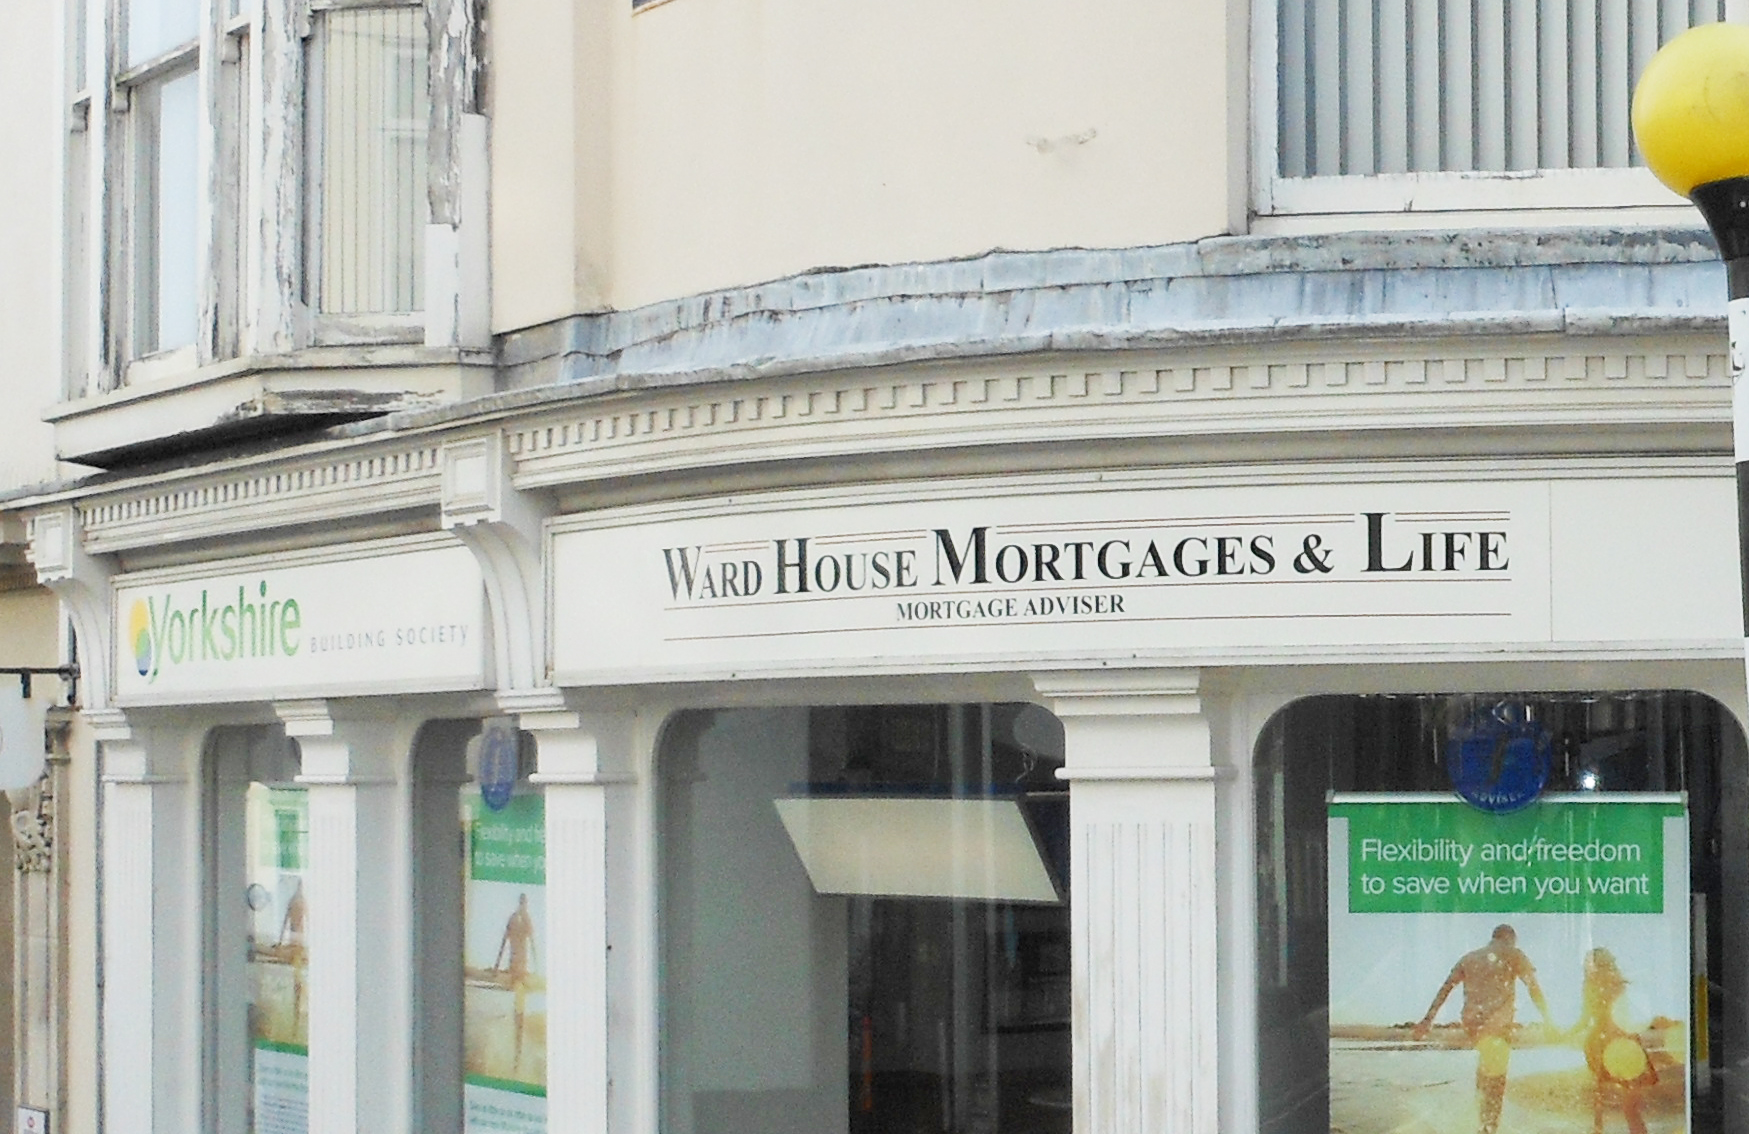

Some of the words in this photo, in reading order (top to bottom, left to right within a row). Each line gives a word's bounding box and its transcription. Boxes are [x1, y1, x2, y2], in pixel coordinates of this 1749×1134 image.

[662, 544, 763, 601] WARD
[773, 536, 919, 595] HOUSE
[931, 526, 1277, 587] MORTGAGES
[1292, 532, 1335, 574] &
[1360, 511, 1511, 573] LIFE
[896, 596, 1018, 622] MORTGAGE
[1023, 593, 1126, 617] ADVISER
[310, 629, 386, 653] BUILDING
[395, 624, 469, 648] SOCIETY
[1361, 838, 1474, 868] Flexibility
[1480, 838, 1528, 862] and
[1534, 837, 1641, 862] freedom
[1361, 873, 1386, 895] to
[1392, 875, 1450, 895] save
[1456, 872, 1527, 895] when
[1534, 876, 1581, 900] you
[1587, 872, 1649, 895] want
